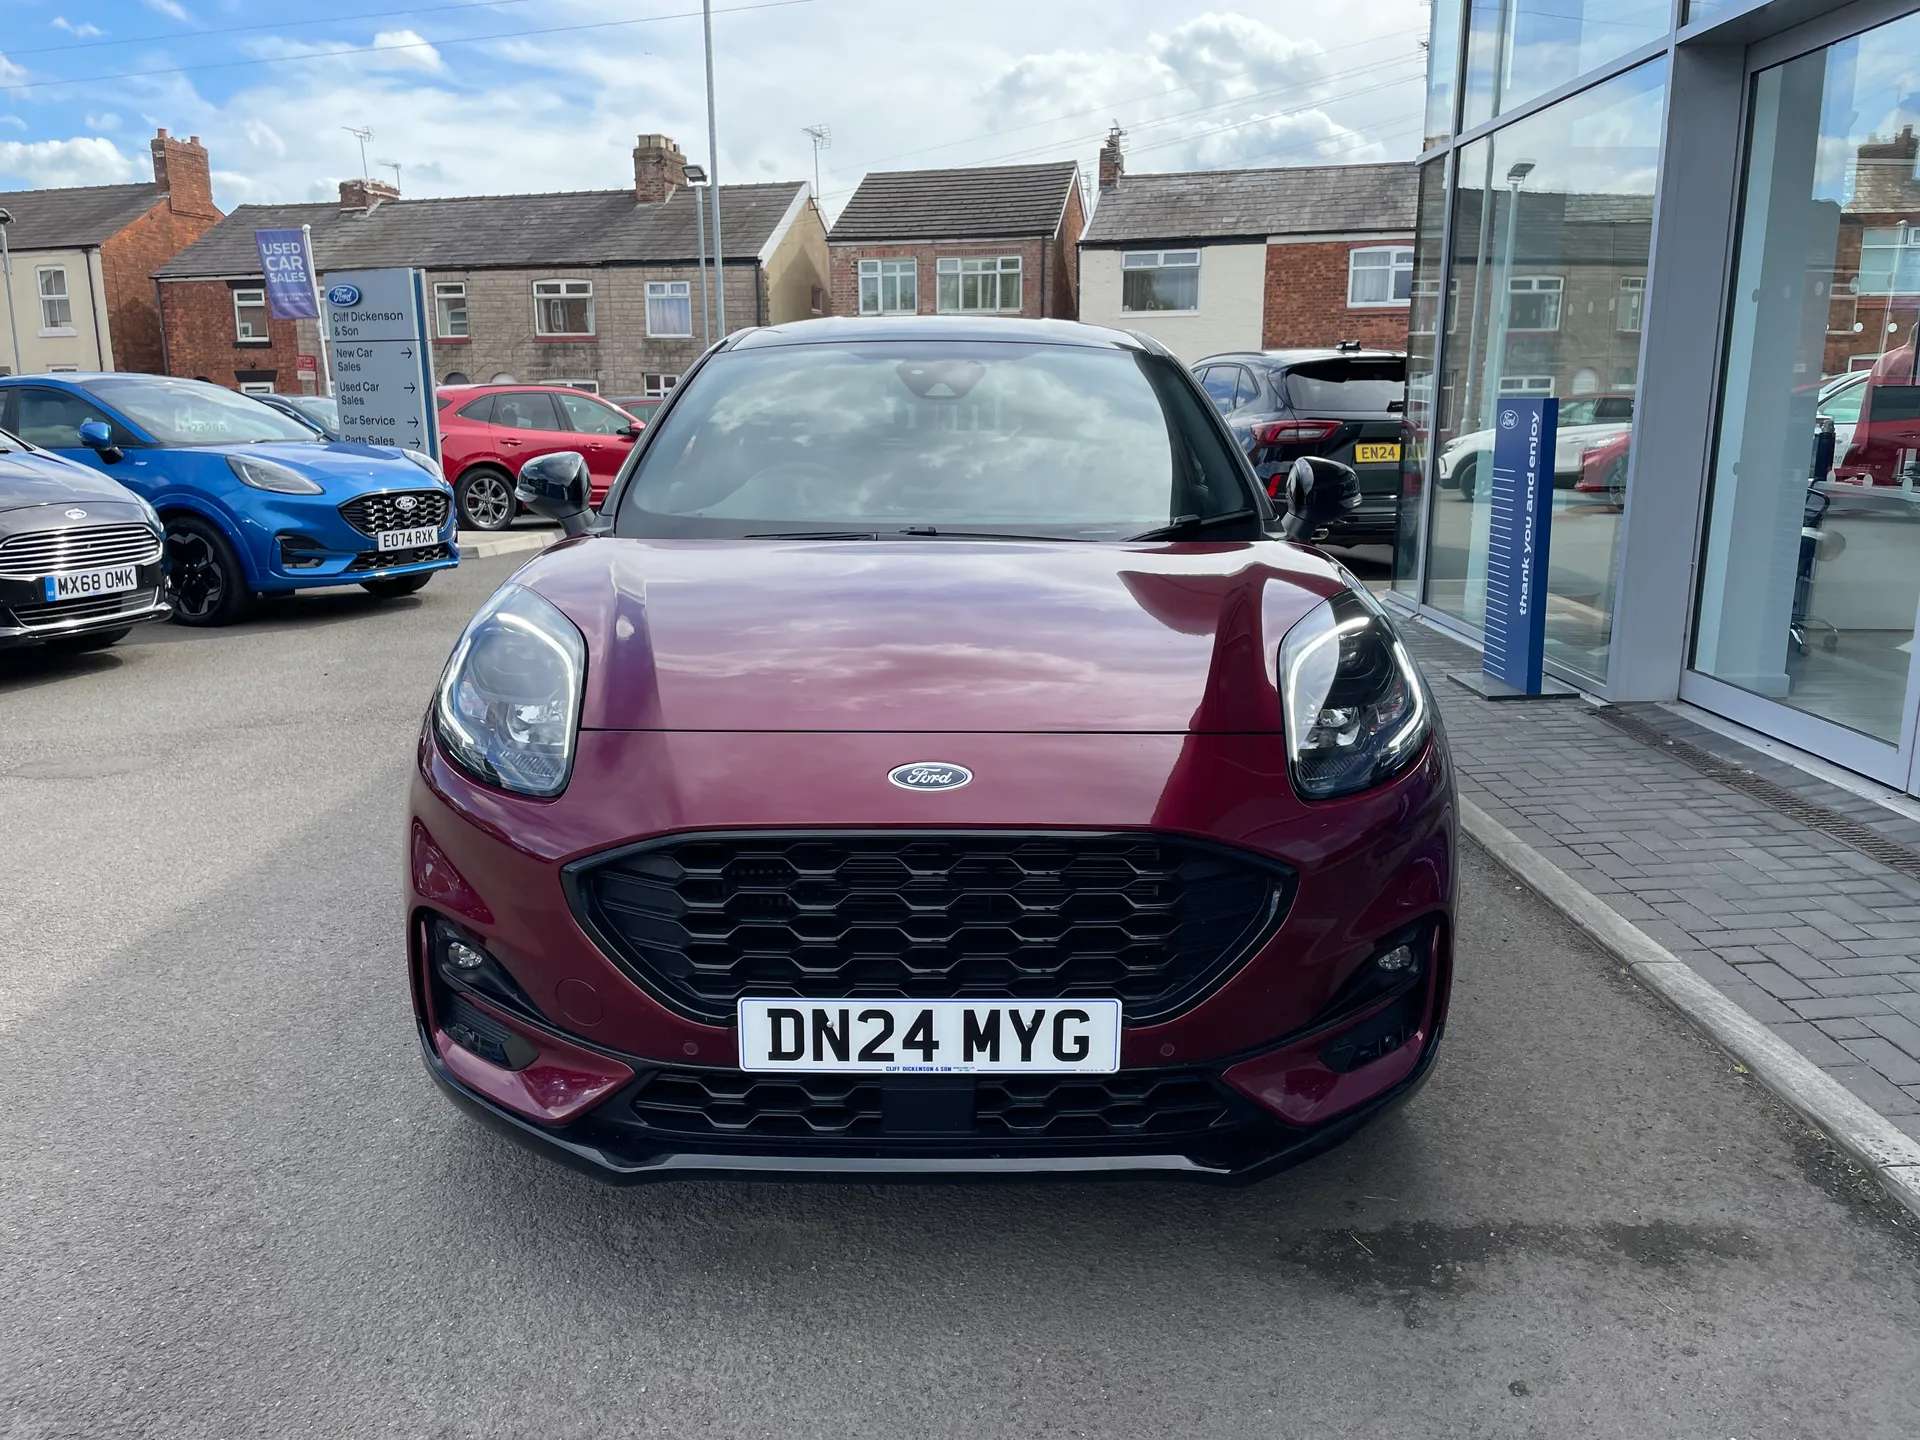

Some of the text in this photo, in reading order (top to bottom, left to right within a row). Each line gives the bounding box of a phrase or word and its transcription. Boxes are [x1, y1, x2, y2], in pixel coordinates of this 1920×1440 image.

[262, 242, 301, 255] USED
[265, 255, 304, 271] CAR
[269, 271, 307, 283] SALES
[333, 288, 353, 302] Ford
[333, 311, 404, 322] Cliff Dickenson
[334, 325, 359, 337] & Son
[336, 347, 373, 358] New Car
[337, 361, 361, 372] Sales
[339, 381, 380, 392] Used Car
[341, 394, 365, 405] Sales
[343, 414, 396, 426] Car Service
[345, 434, 395, 446] Parts Sales
[1361, 446, 1396, 460] EN24
[1519, 410, 1540, 616] thank you and enjoy
[383, 529, 434, 548] EO74 RXK
[58, 568, 134, 596] MX68 OMK
[907, 767, 953, 784] Ford
[767, 1008, 1090, 1062] DN24 MYG
